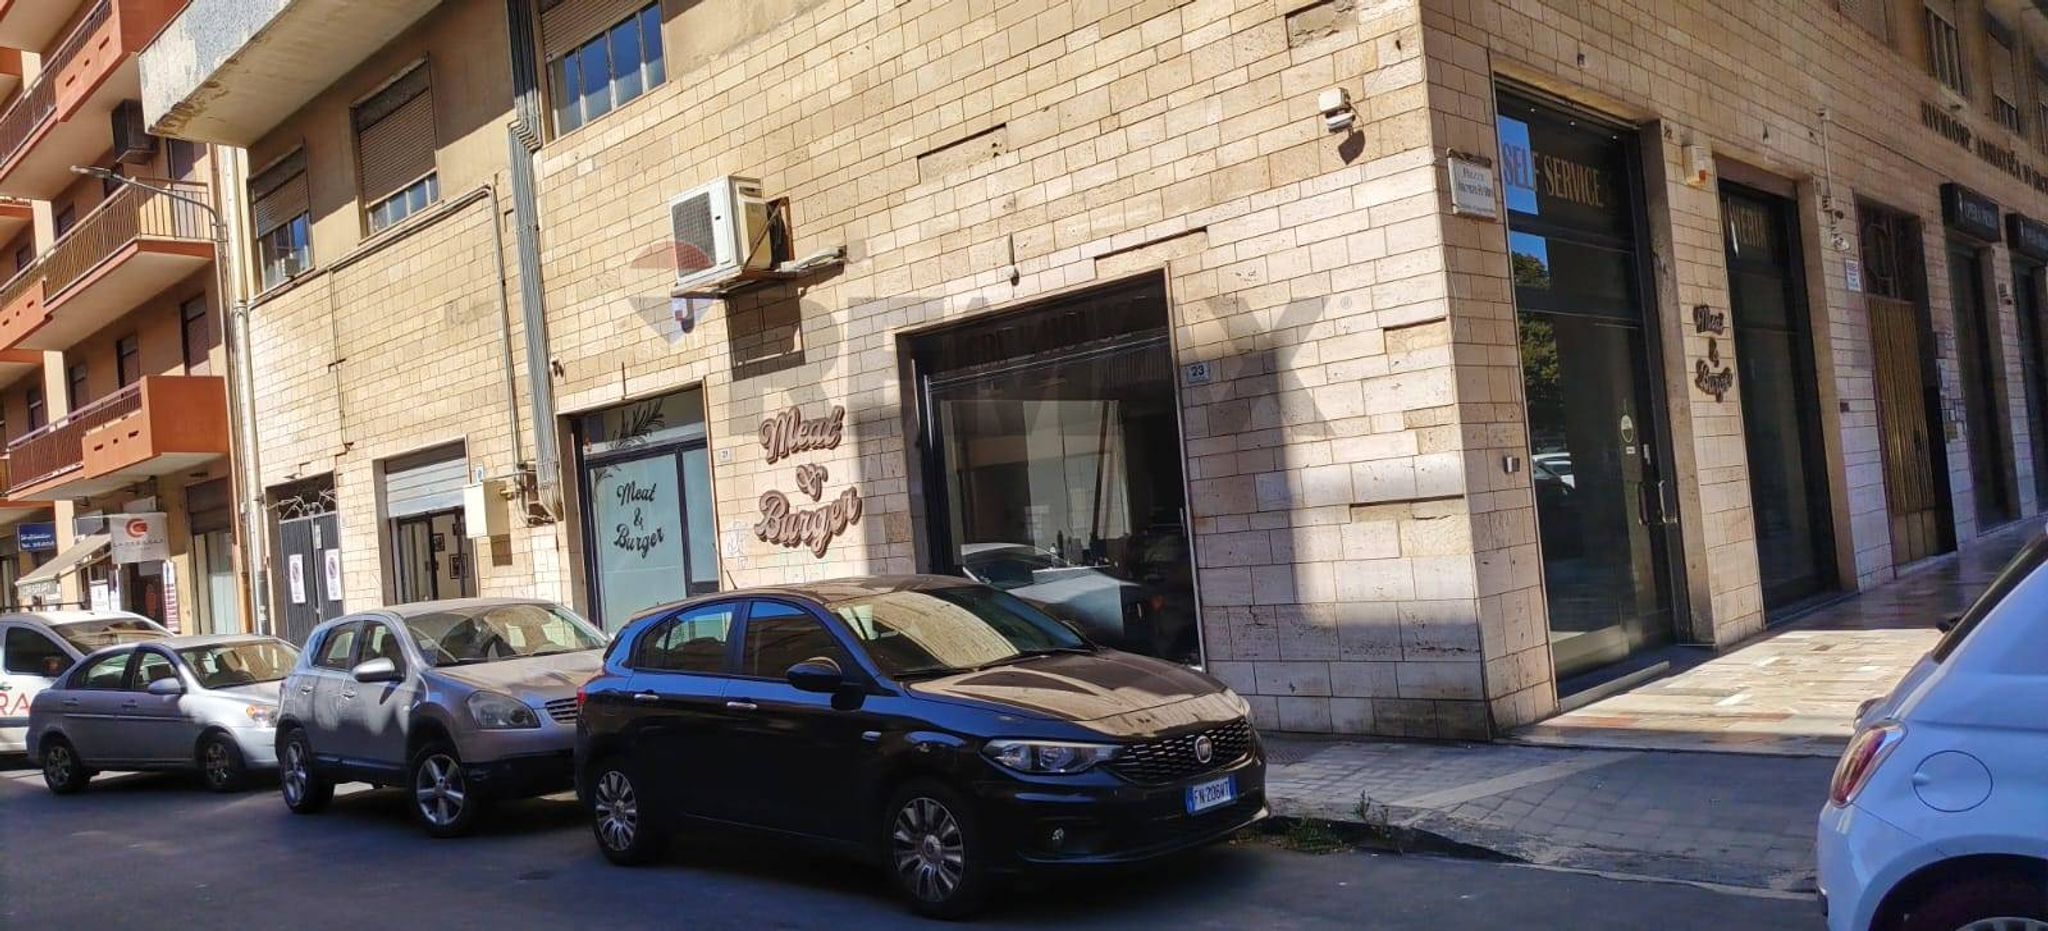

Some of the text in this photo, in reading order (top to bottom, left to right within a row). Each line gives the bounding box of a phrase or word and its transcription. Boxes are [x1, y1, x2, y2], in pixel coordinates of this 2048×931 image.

[1502, 142, 1604, 208] SELF SERVICE
[1191, 364, 1205, 377] 23
[759, 405, 845, 465] Meat
[616, 481, 657, 506] Meat
[796, 463, 828, 502] &
[633, 507, 644, 530] &
[754, 487, 862, 559] Burger
[613, 523, 664, 559] Burger
